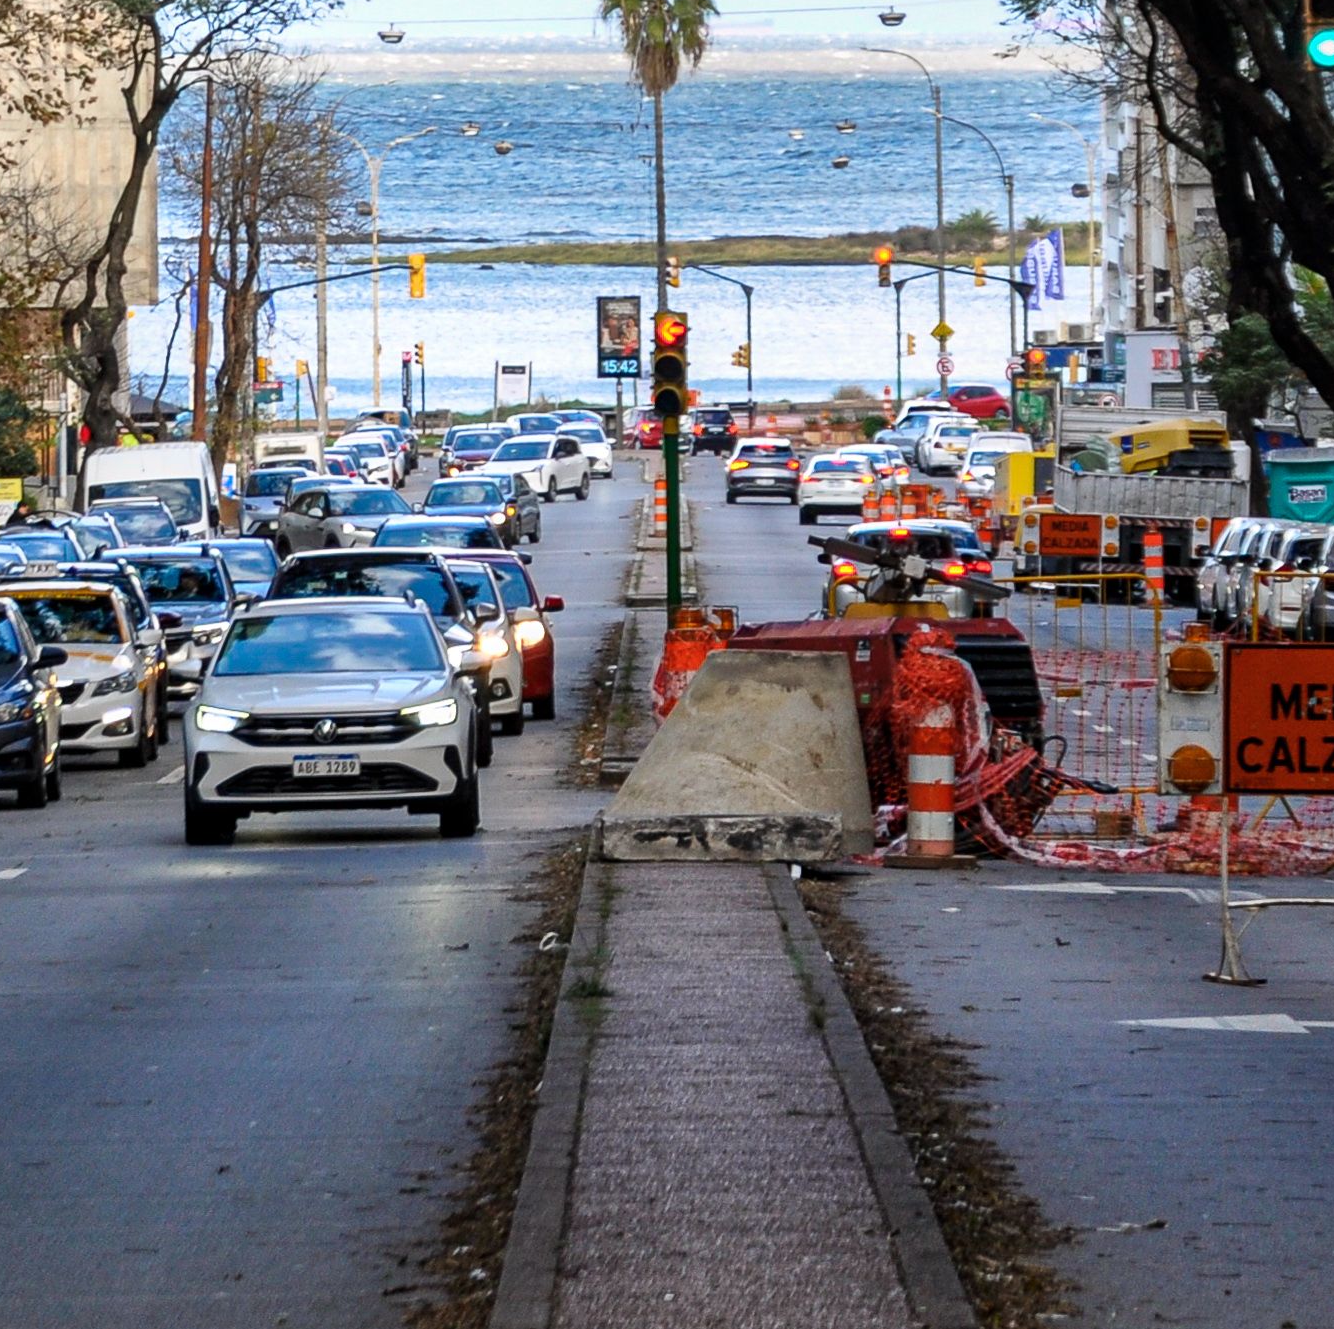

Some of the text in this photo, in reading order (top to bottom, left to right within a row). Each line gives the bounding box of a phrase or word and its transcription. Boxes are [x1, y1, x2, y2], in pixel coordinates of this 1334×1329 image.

[602, 359, 638, 374] 15:42
[1051, 521, 1089, 532] MEDIA
[1042, 537, 1099, 549] CALZADA
[298, 761, 357, 773] ABE 1289
